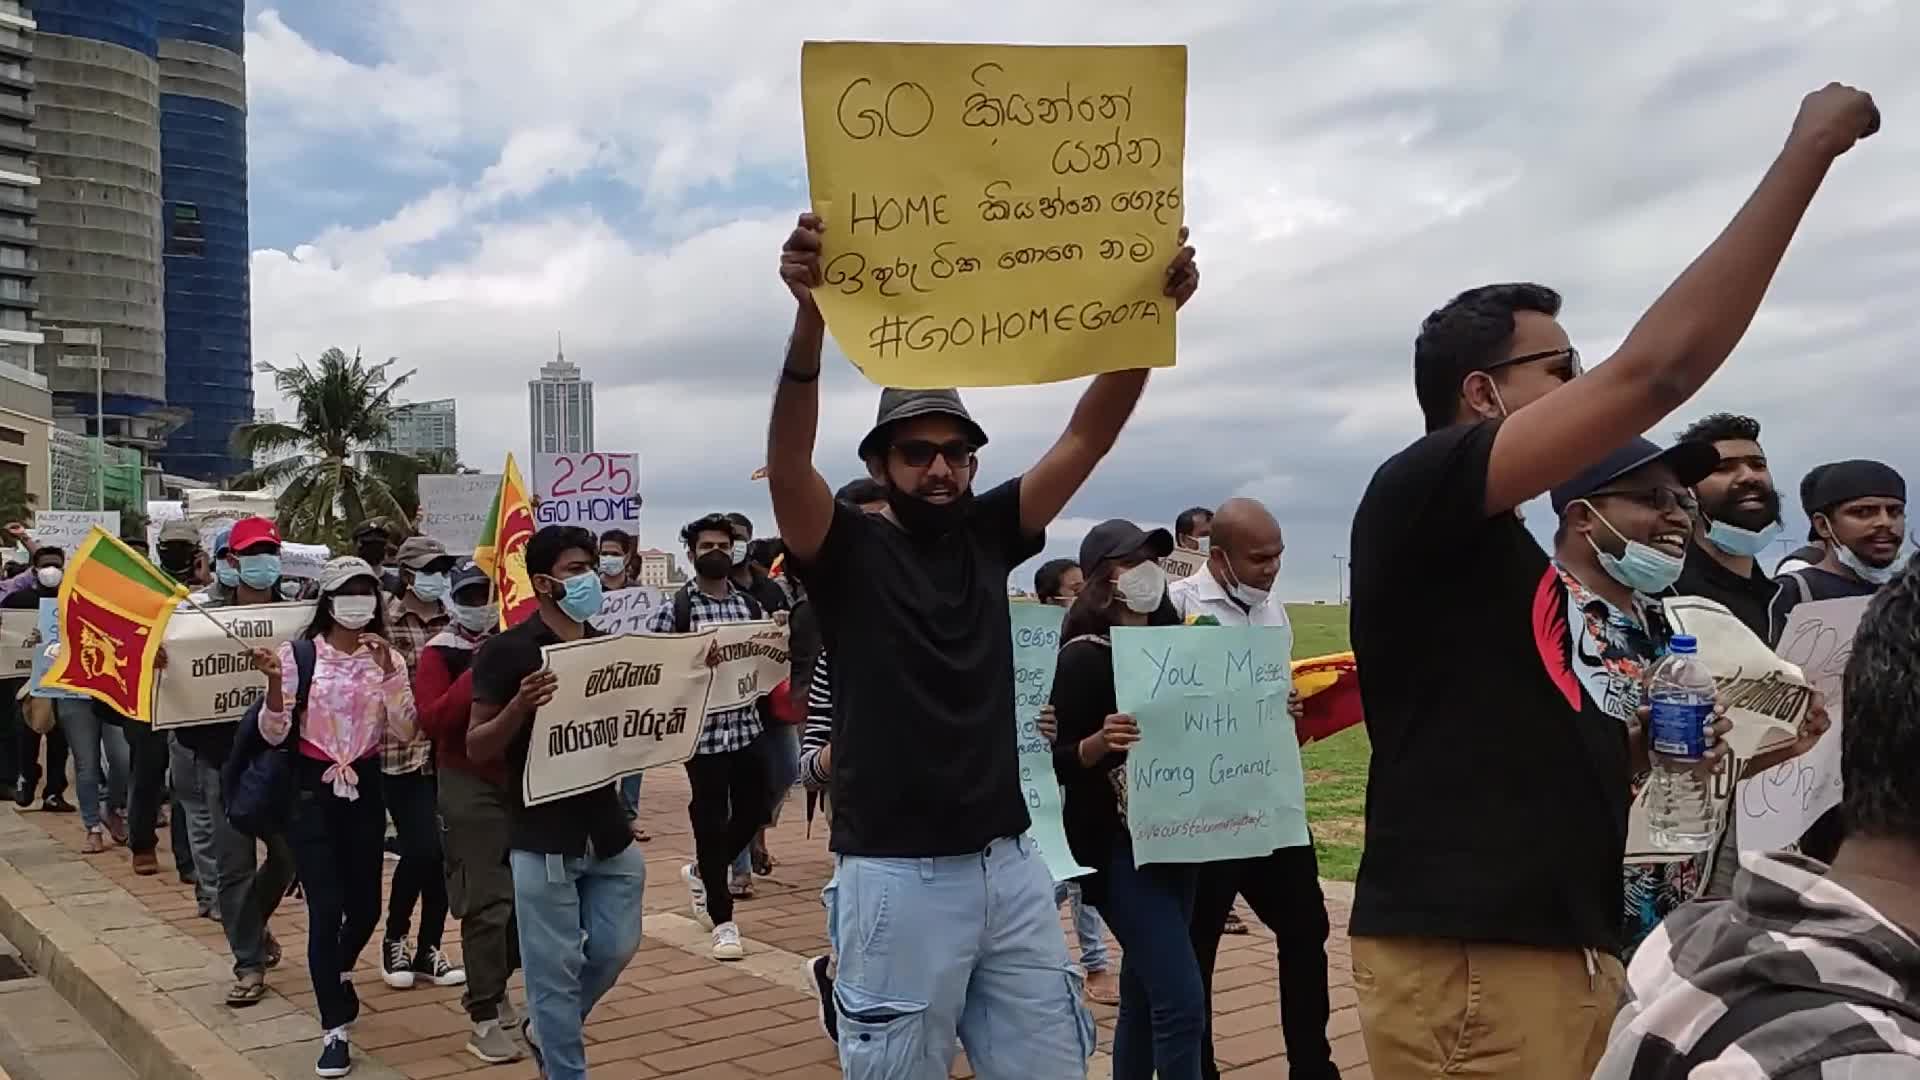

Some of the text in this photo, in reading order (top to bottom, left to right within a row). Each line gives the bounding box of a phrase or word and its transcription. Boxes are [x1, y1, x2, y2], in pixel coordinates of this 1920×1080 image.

[837, 78, 934, 139] GO
[1052, 126, 1161, 174] යන්න
[851, 192, 951, 235] HOME
[1111, 187, 1180, 225] ගෙදර
[869, 300, 1160, 358] #GOHOMEGOTA
[551, 453, 632, 497] 225
[537, 496, 640, 523] GO HOME
[1142, 645, 1203, 699] You
[549, 707, 688, 757] බරපතල වරදකි
[1134, 758, 1195, 797] Wrong
